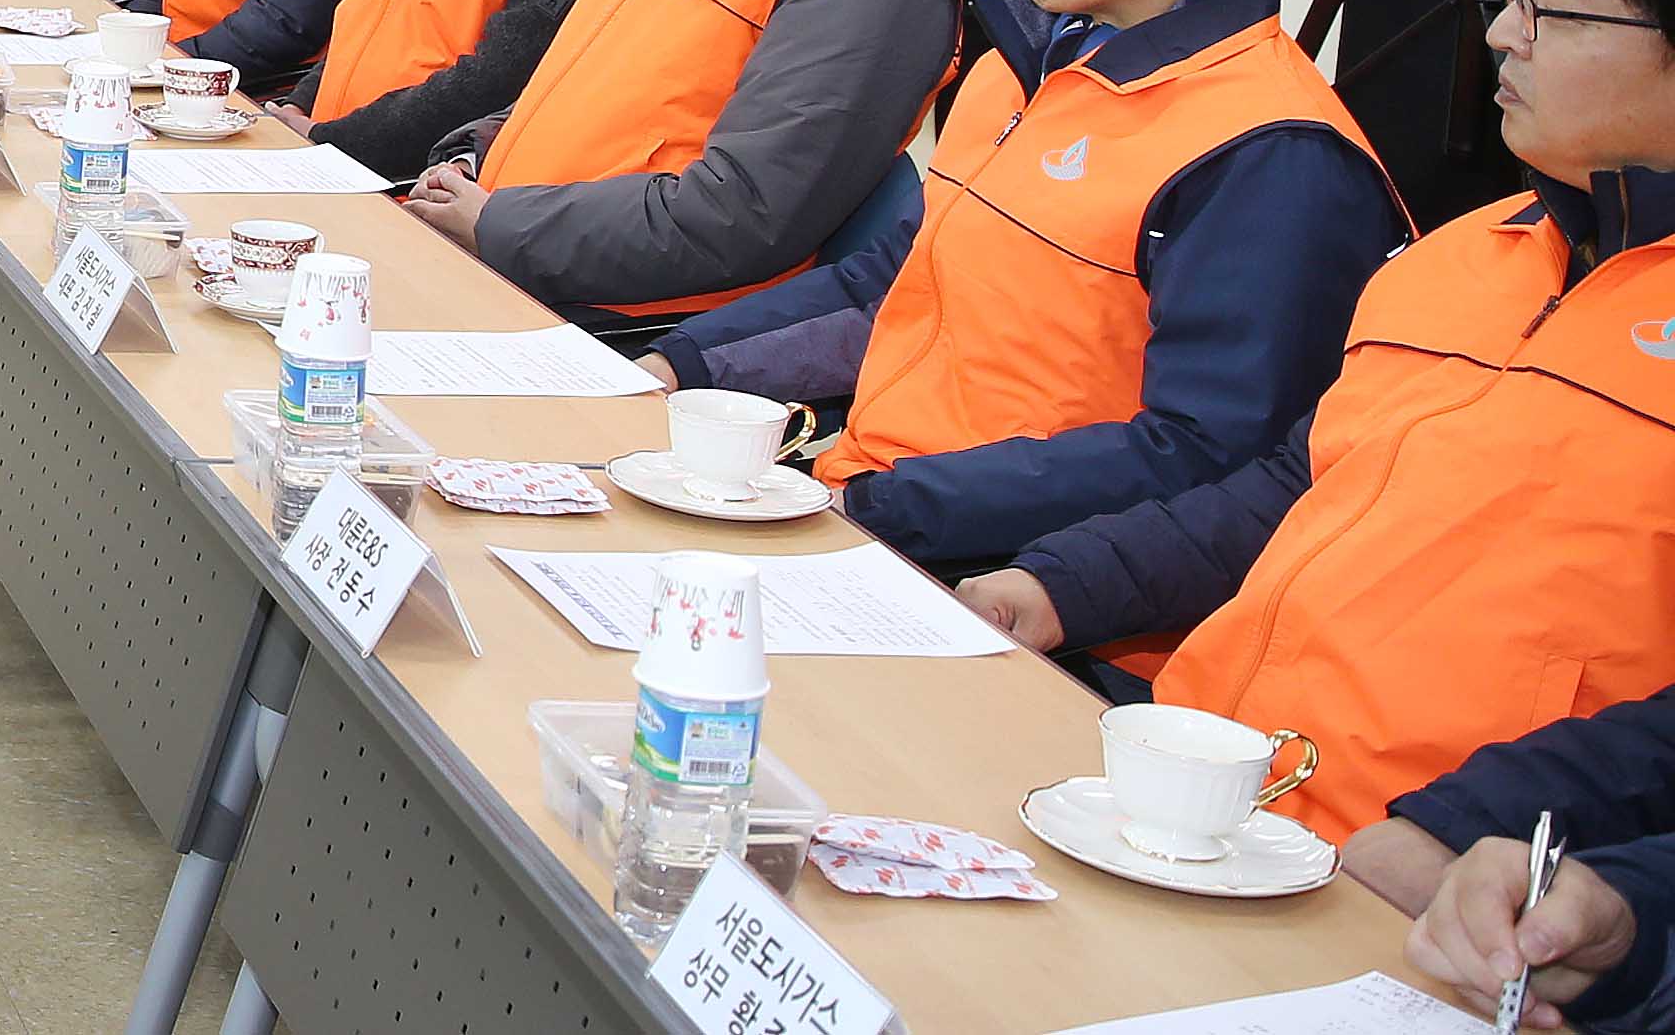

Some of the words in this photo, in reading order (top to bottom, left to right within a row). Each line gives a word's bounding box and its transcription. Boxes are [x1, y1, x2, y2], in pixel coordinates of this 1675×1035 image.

[58, 272, 76, 299] 대표
[75, 244, 117, 298] 서울도시가스
[304, 532, 333, 572] 사장
[337, 506, 390, 568] 대륜E&S
[683, 947, 731, 1005] 상무
[715, 900, 840, 1035] 서울도시가스
